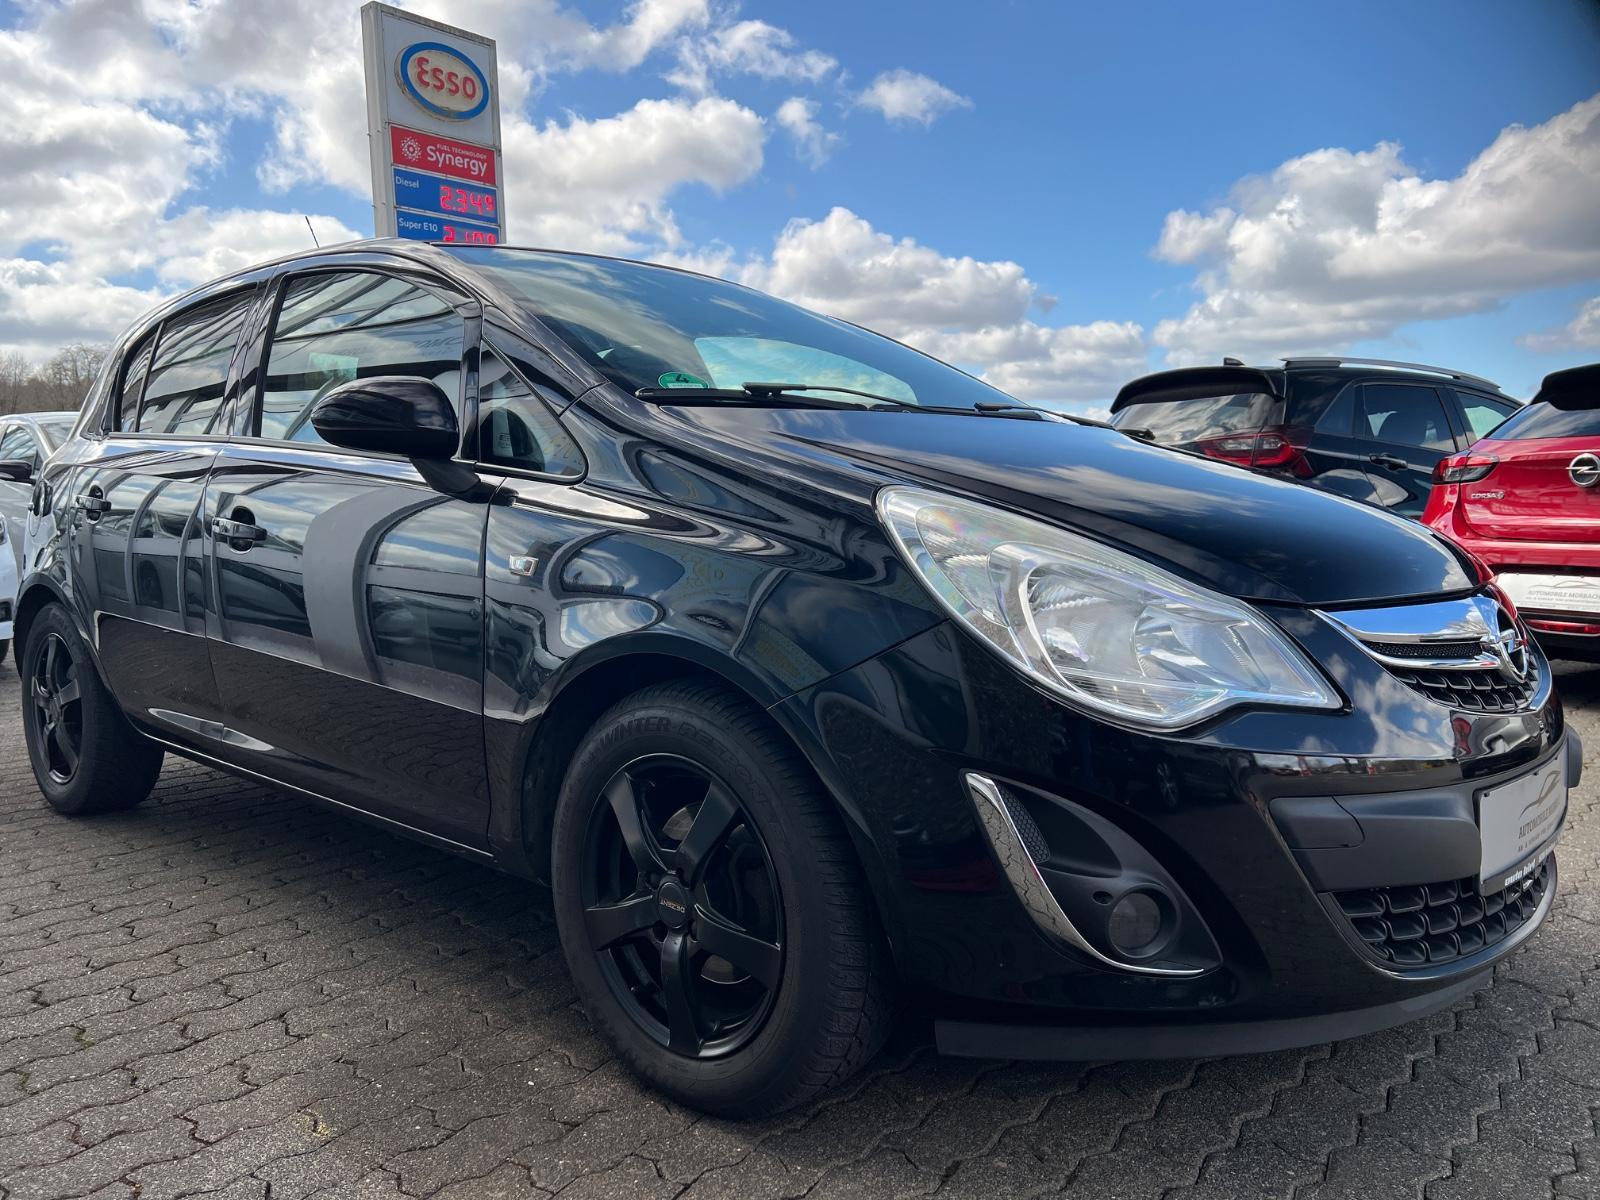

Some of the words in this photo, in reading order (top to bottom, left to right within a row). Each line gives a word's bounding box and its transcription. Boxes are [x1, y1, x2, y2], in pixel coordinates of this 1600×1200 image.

[437, 143, 451, 152] FUEL
[452, 147, 487, 160] TECHNOLOGY
[426, 145, 487, 177] Synergy
[395, 176, 419, 189] Diesel
[440, 185, 495, 215] 2.349
[398, 218, 421, 231] Super
[423, 222, 438, 232] E10
[675, 373, 690, 384] 4
